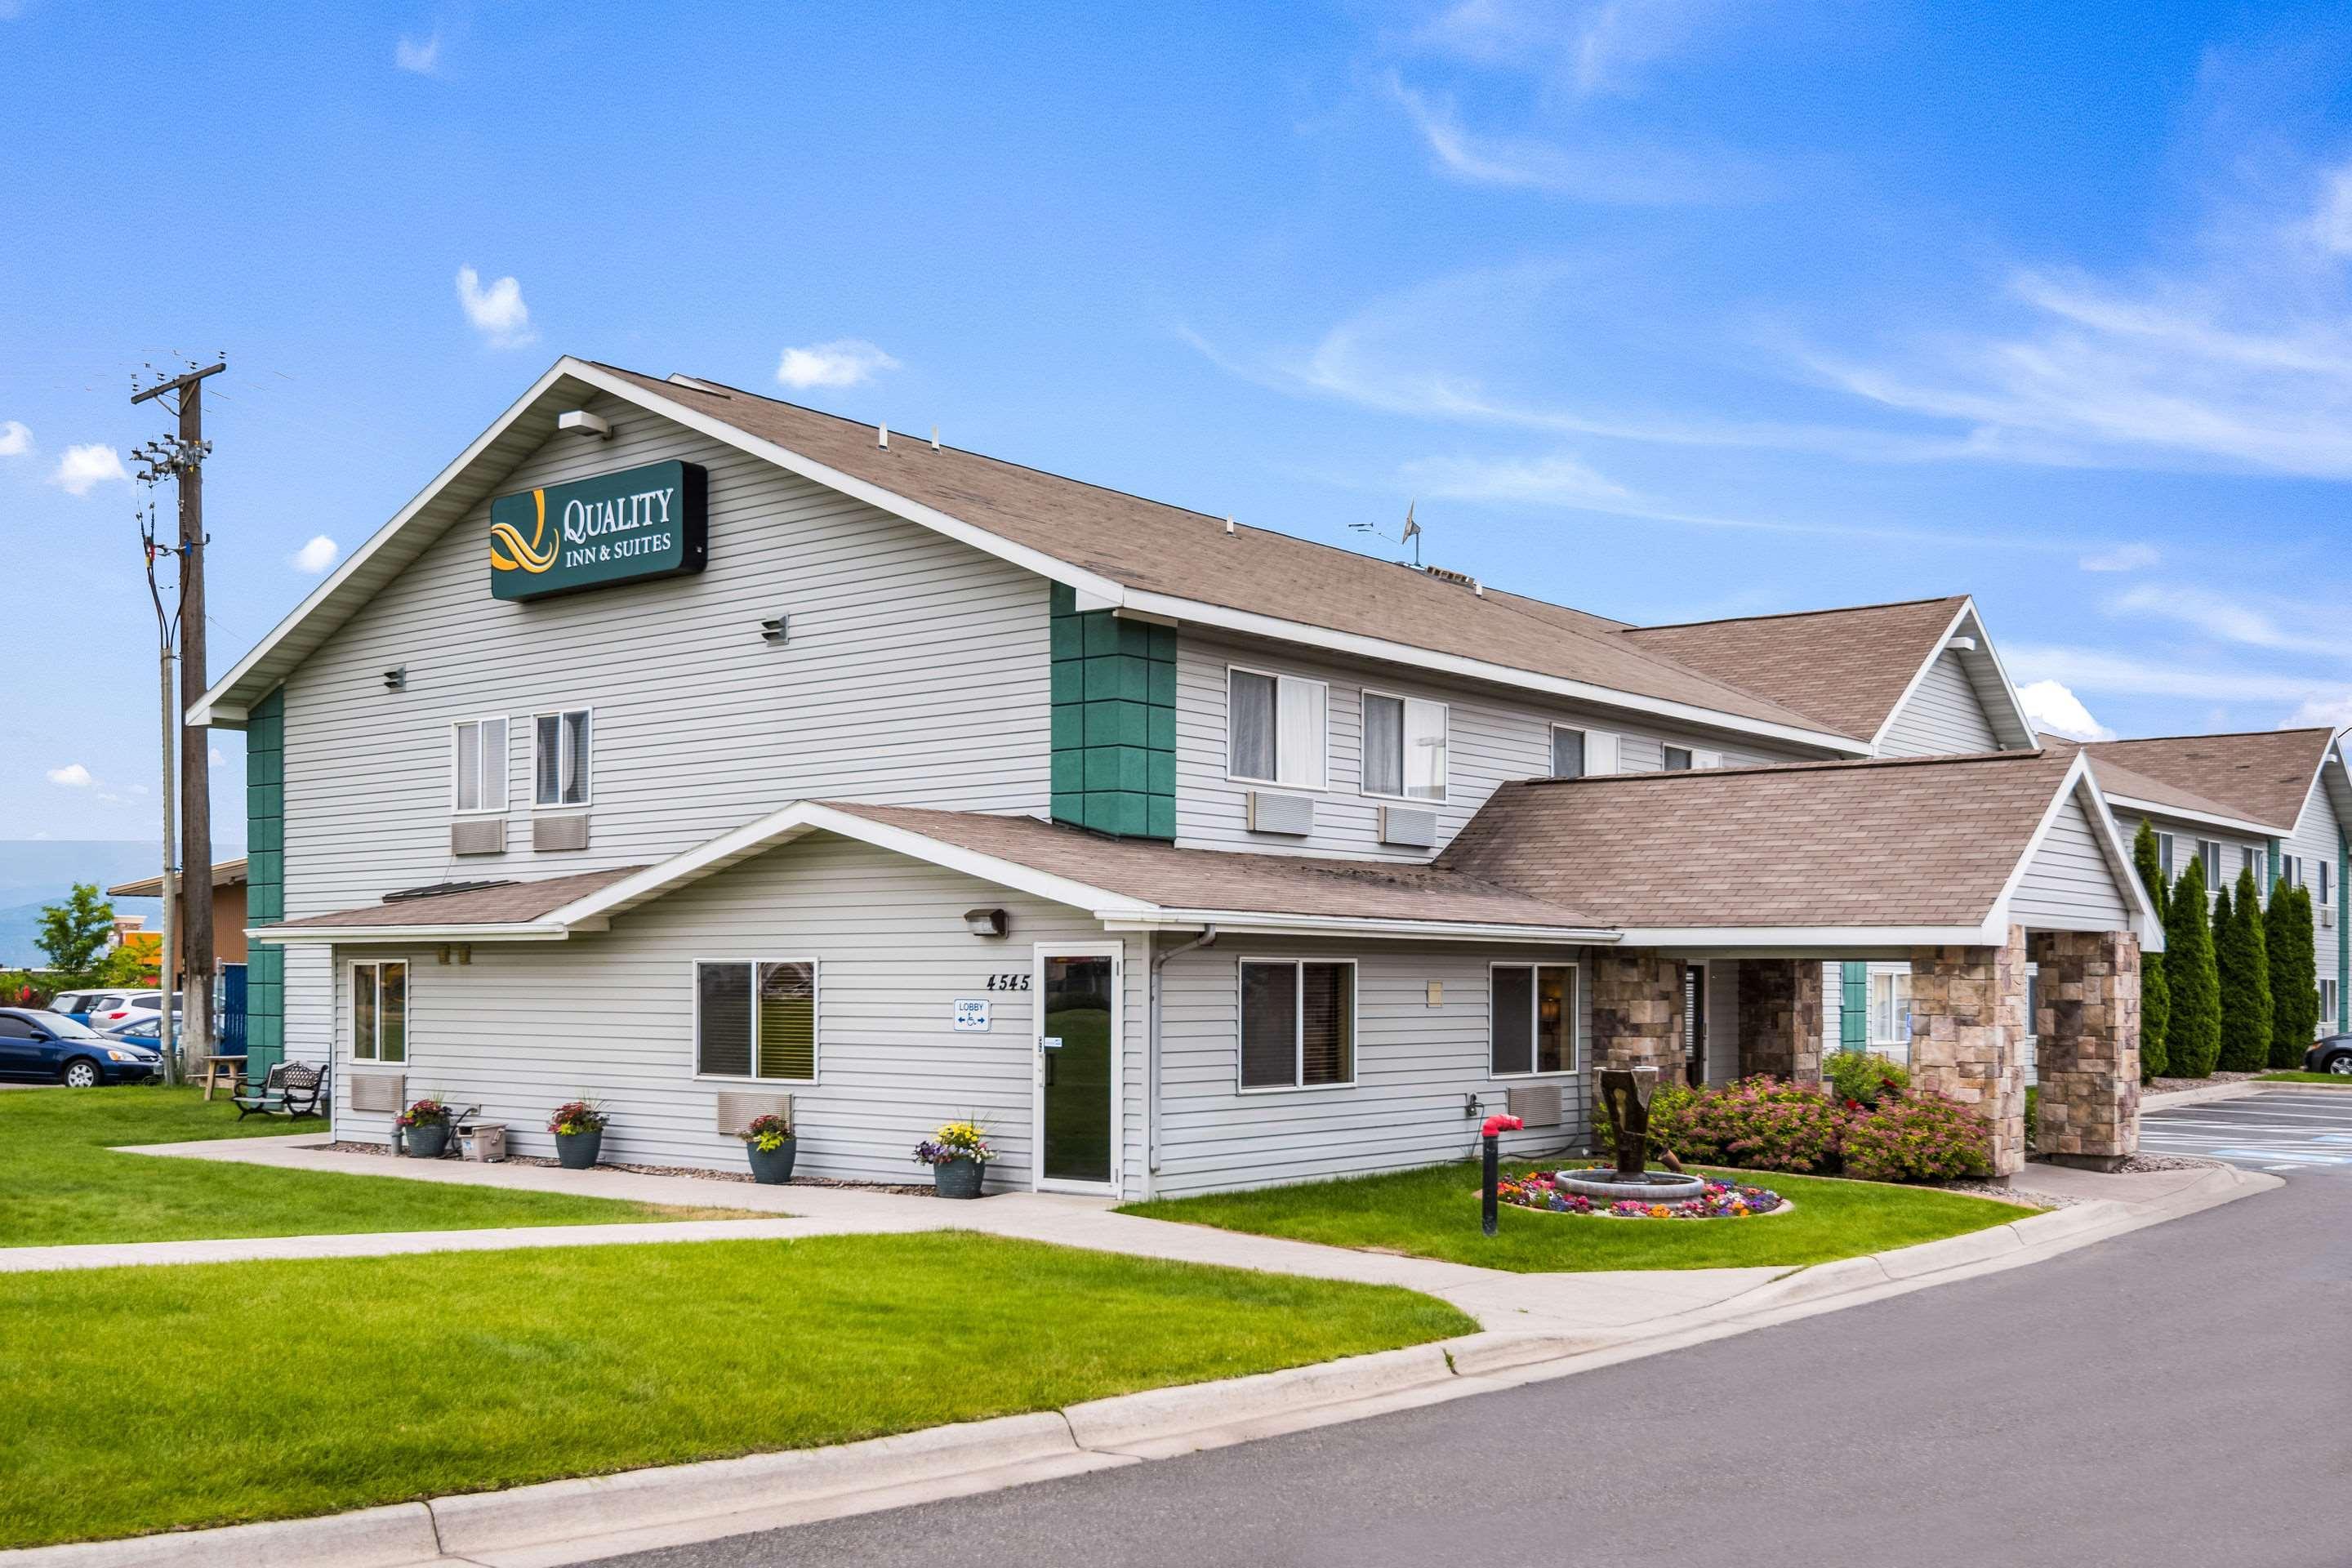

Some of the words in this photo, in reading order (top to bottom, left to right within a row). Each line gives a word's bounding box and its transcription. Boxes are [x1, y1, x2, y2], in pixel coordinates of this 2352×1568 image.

[564, 488, 673, 544] QUALITY
[566, 546, 596, 568] INN
[600, 544, 611, 561] &
[614, 532, 671, 559] SUITES
[987, 974, 1030, 991] 4545
[959, 1003, 983, 1011] LOBBY
